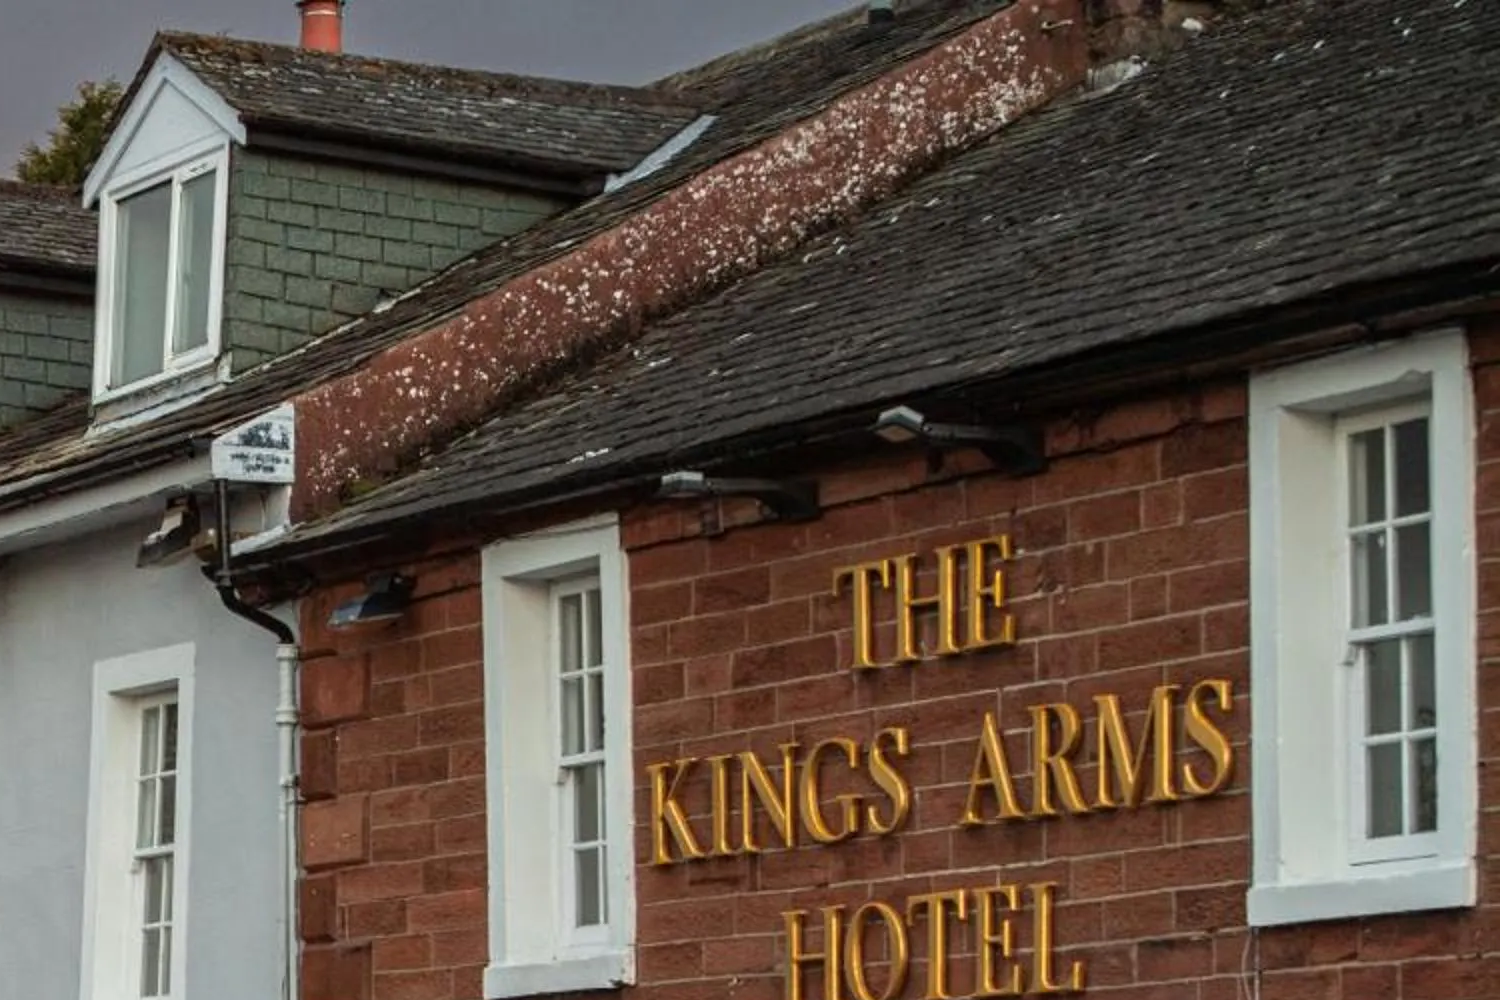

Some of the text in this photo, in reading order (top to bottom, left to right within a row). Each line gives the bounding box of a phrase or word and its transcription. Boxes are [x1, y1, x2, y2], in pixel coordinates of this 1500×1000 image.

[833, 533, 1017, 669] THE
[645, 678, 1236, 865] KINGS ARMS
